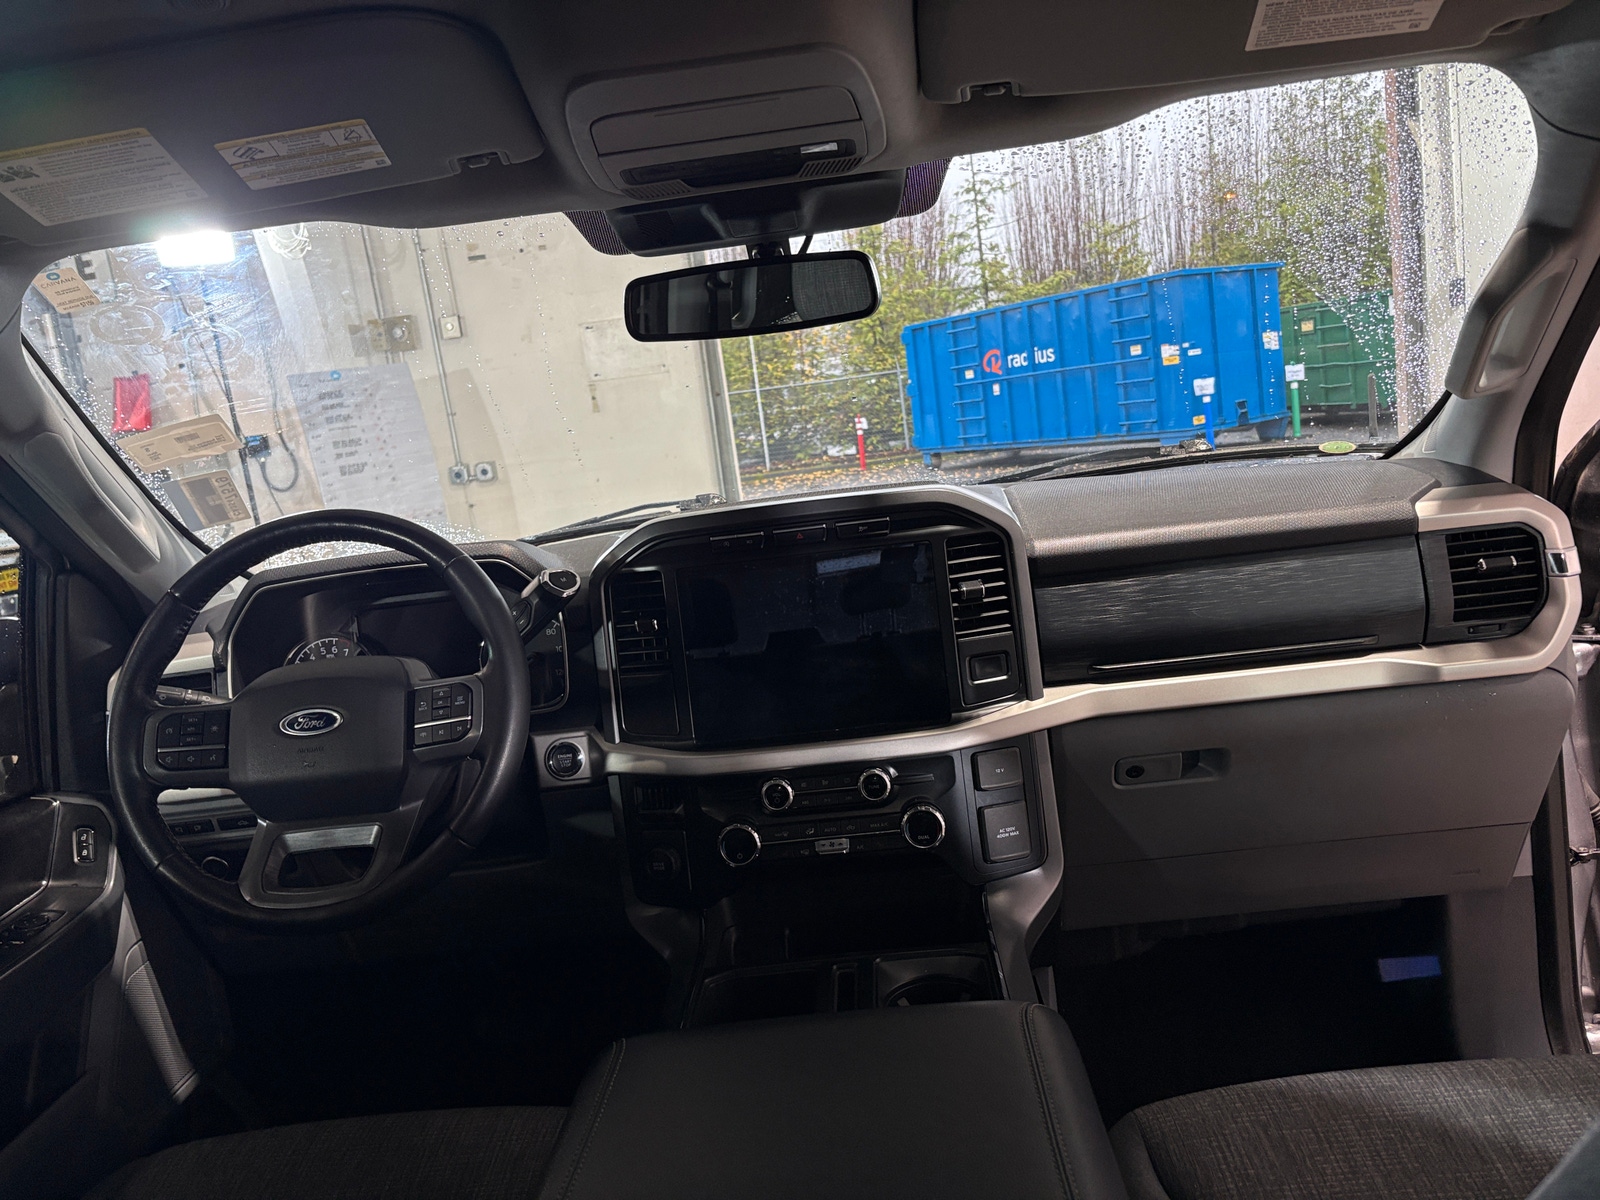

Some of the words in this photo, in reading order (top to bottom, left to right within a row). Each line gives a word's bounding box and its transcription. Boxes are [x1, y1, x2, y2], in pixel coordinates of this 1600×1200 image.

[40, 276, 77, 289] CARVANA
[545, 628, 557, 636] 80
[320, 646, 327, 656] 5
[331, 645, 338, 654] 6
[343, 648, 349, 657] 7
[309, 653, 316, 661] 4
[294, 714, 327, 730] Ford
